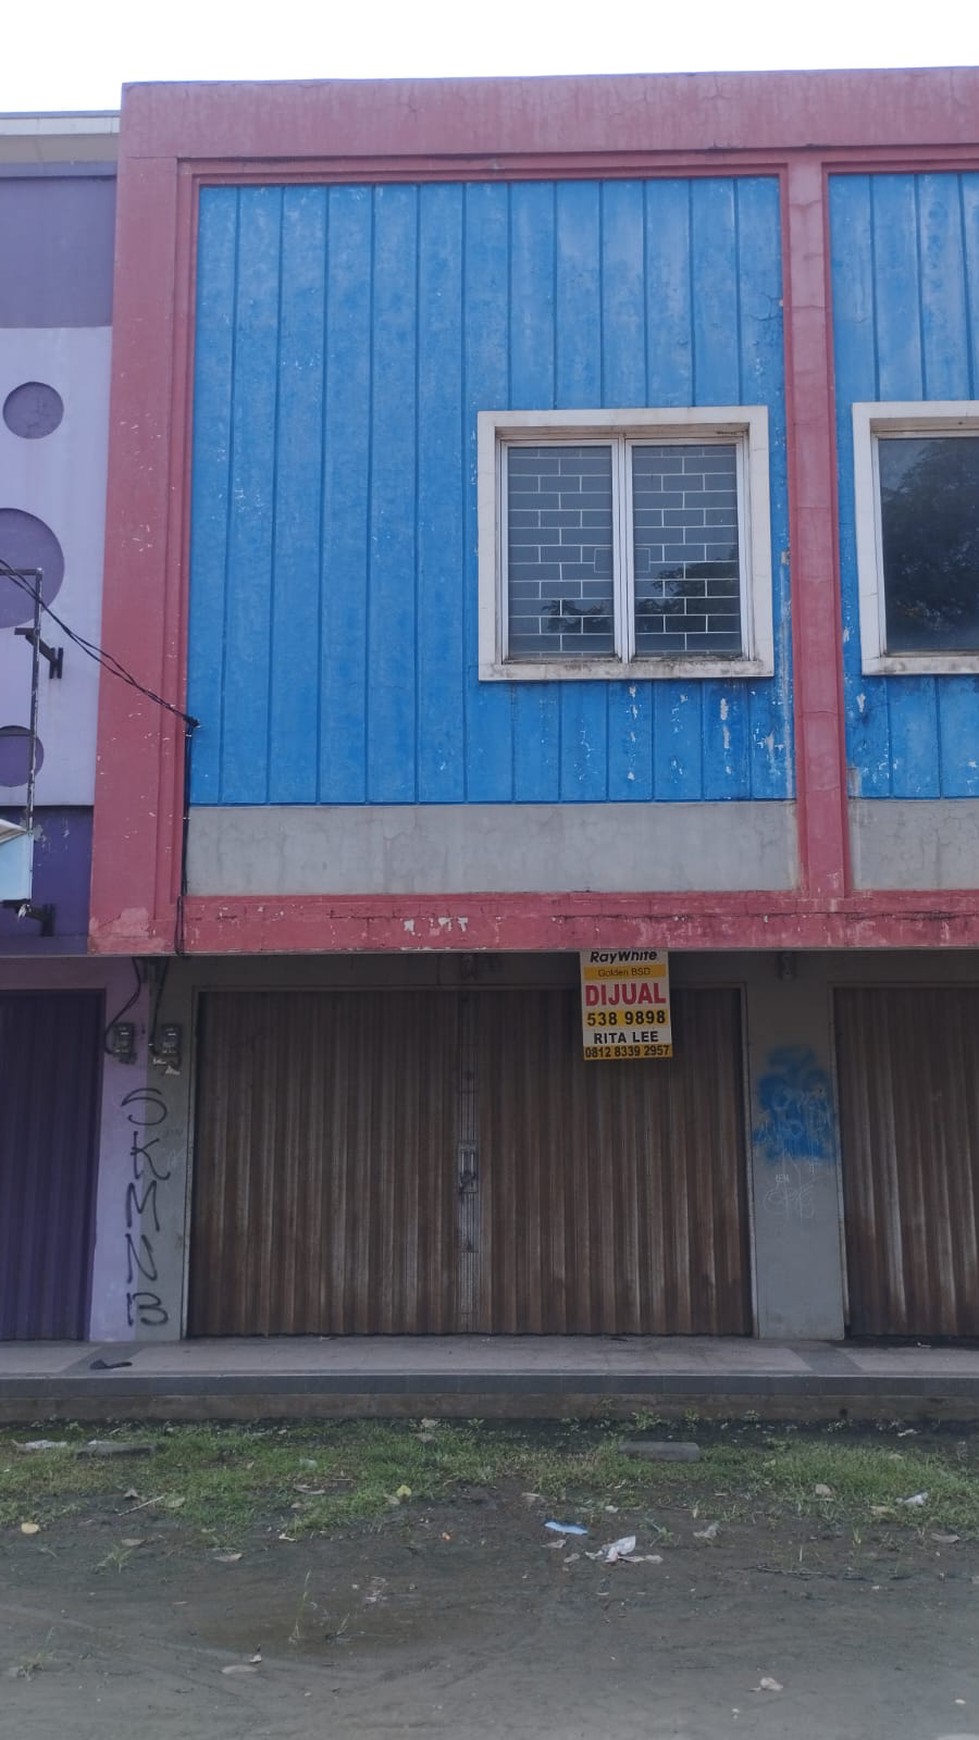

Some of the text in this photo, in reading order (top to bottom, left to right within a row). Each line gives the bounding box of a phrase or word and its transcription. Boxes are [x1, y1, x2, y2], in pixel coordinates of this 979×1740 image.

[598, 968, 651, 977] Golden BSD
[585, 983, 667, 1006] DIJUAL
[587, 1010, 666, 1026] 538 9898
[594, 1031, 659, 1044] RITA LEE
[585, 1045, 670, 1058] 0812 8339 2957
